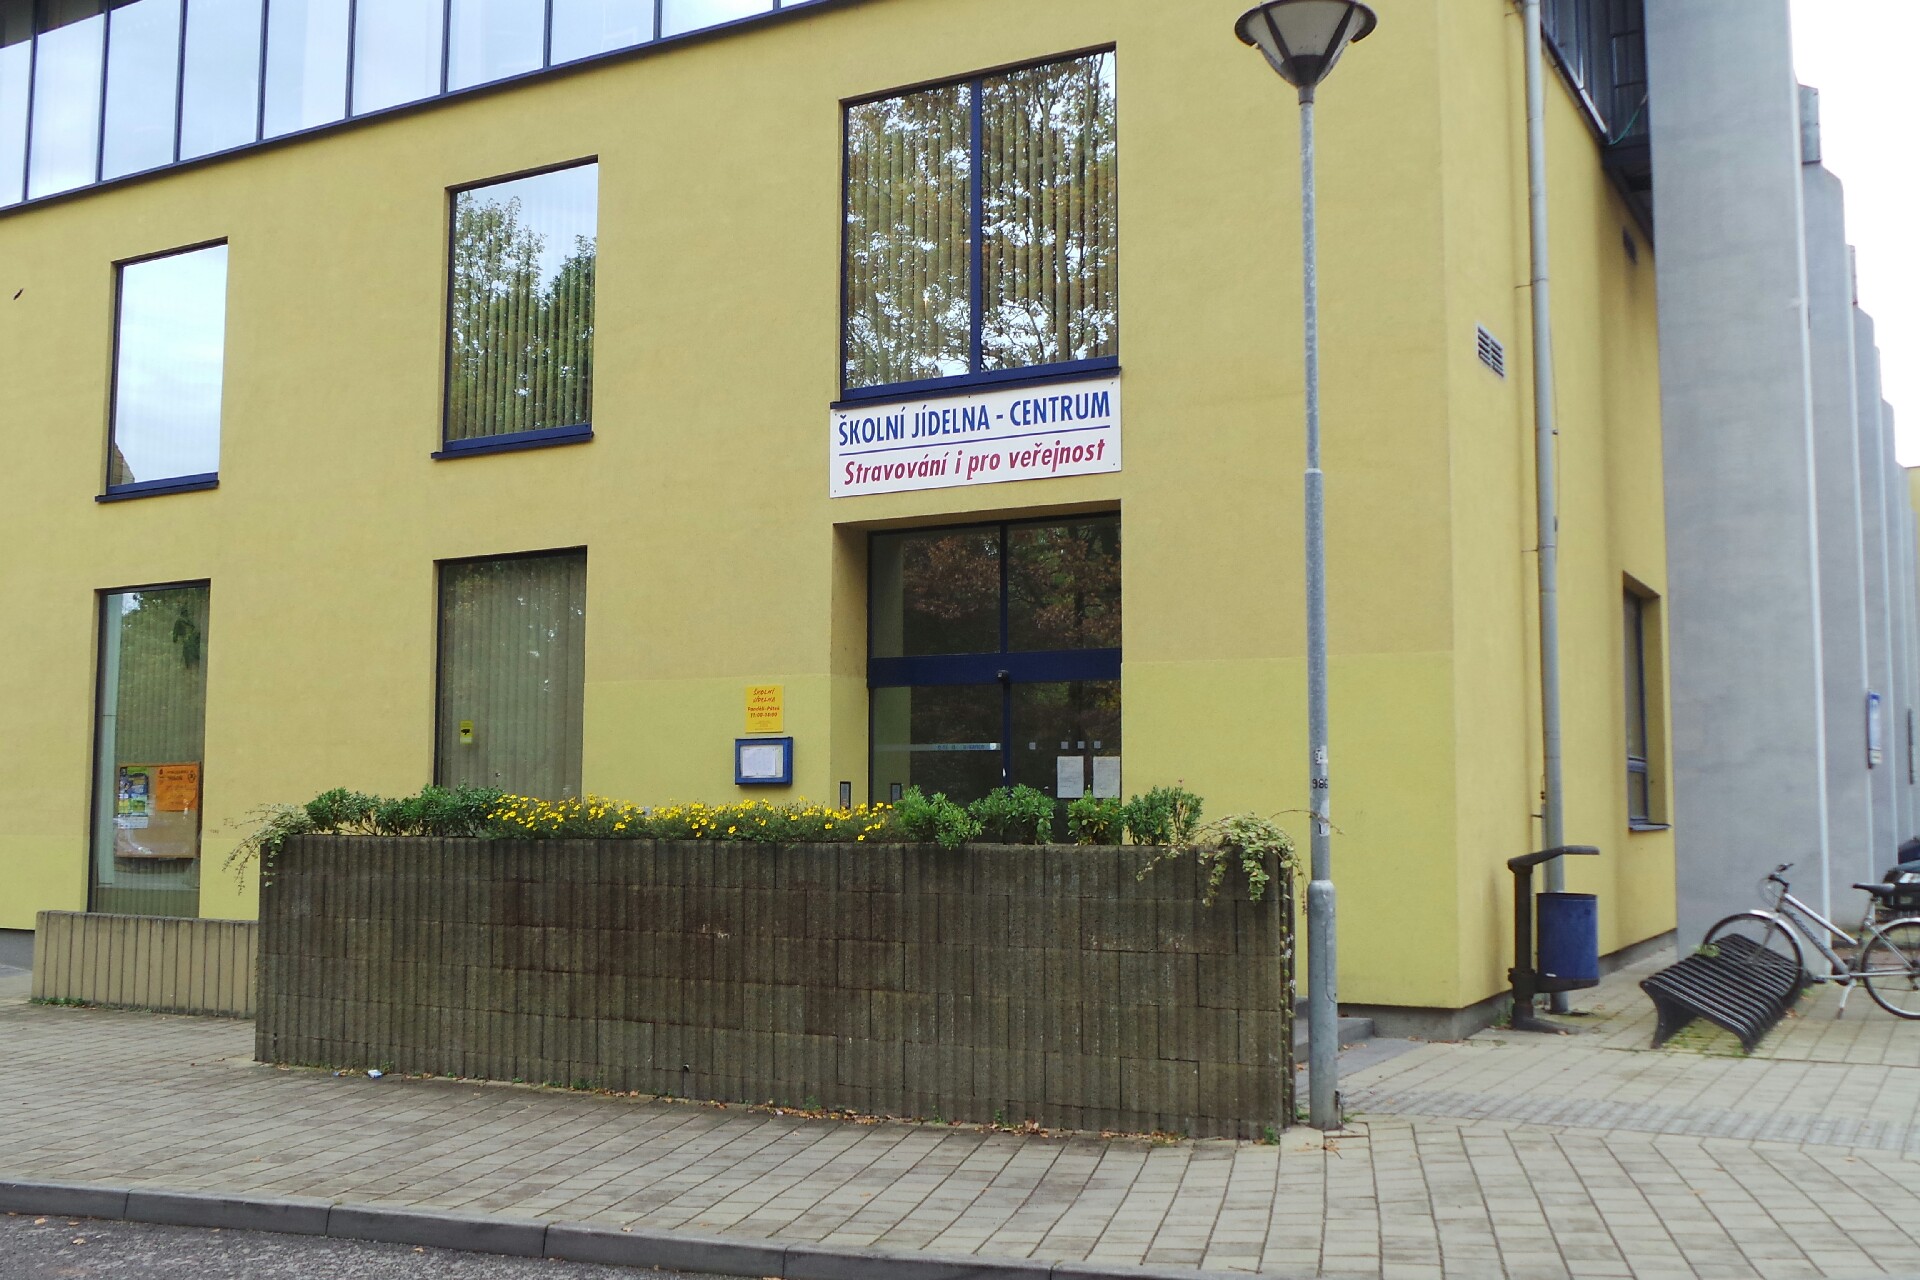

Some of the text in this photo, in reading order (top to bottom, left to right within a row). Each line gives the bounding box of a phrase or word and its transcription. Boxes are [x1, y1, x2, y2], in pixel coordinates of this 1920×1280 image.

[839, 406, 906, 446] ŠKOLNÍ
[911, 404, 990, 438] JÍDELNA
[1009, 390, 1111, 426] CENTRUM
[844, 438, 1106, 485] Stravování i pro veřejnost
